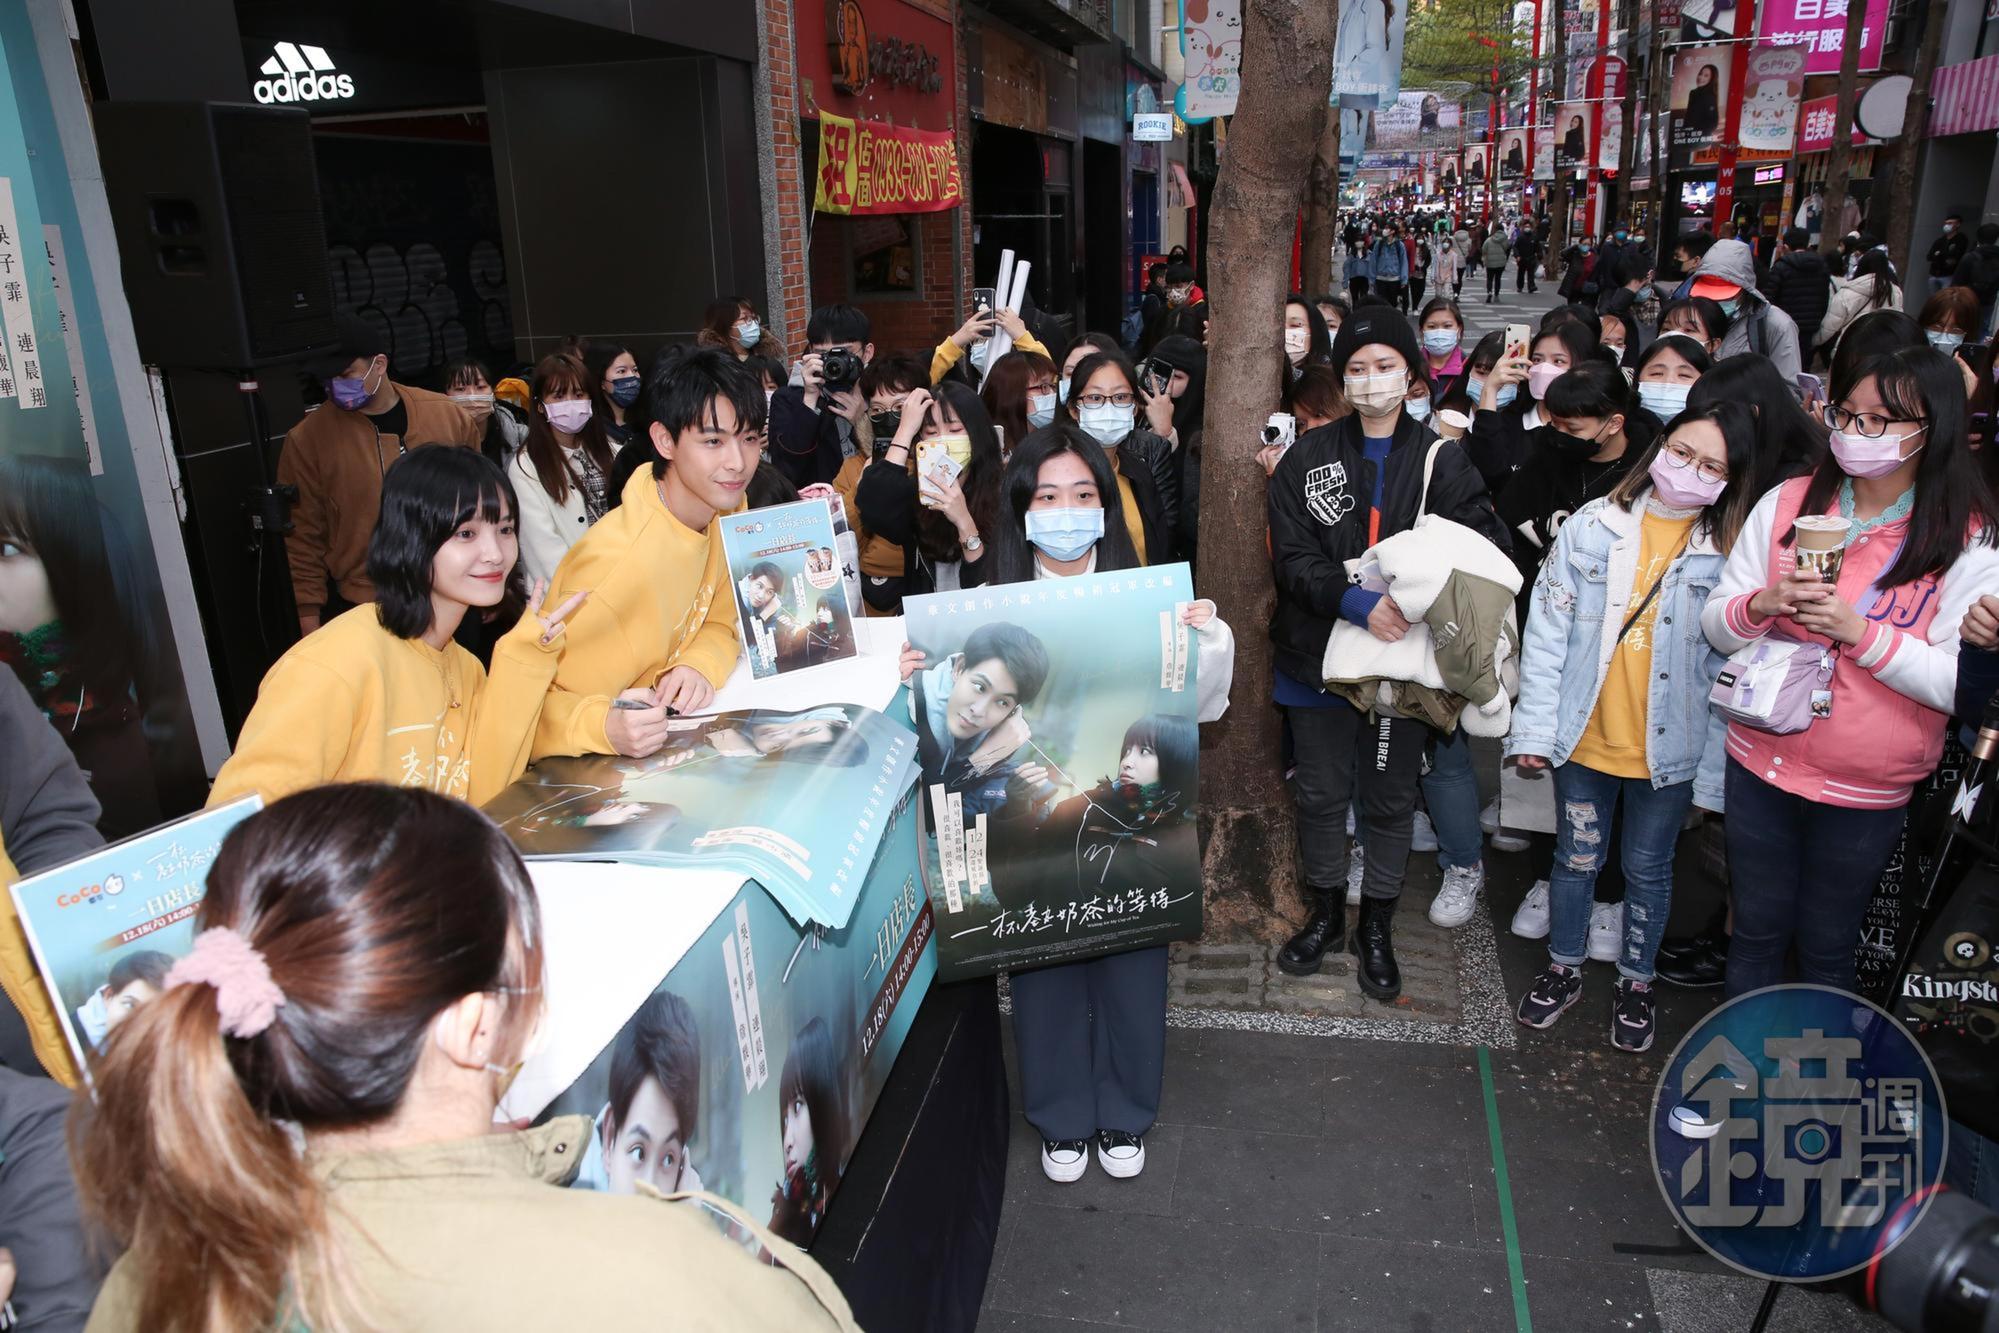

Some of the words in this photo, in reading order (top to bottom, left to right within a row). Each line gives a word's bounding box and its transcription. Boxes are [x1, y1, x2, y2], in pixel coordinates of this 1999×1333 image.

[254, 71, 355, 104] adidas
[1138, 120, 1167, 131] ROOKIE
[857, 129, 872, 207] 店面
[1722, 168, 1733, 177] W
[1719, 186, 1732, 196] 05
[17, 331, 47, 408] 連晨翔
[1305, 472, 1347, 498] FRESH
[1307, 462, 1344, 486] 100%
[1379, 718, 1391, 740] MINI
[56, 884, 101, 909] CoCo
[128, 880, 201, 918] 一日店長
[863, 873, 916, 980] 一日店長
[951, 887, 1194, 939] 一杯熱奶茶的等待
[862, 982, 895, 1057] 12.18(六)
[895, 912, 931, 991] 14:00-15:00
